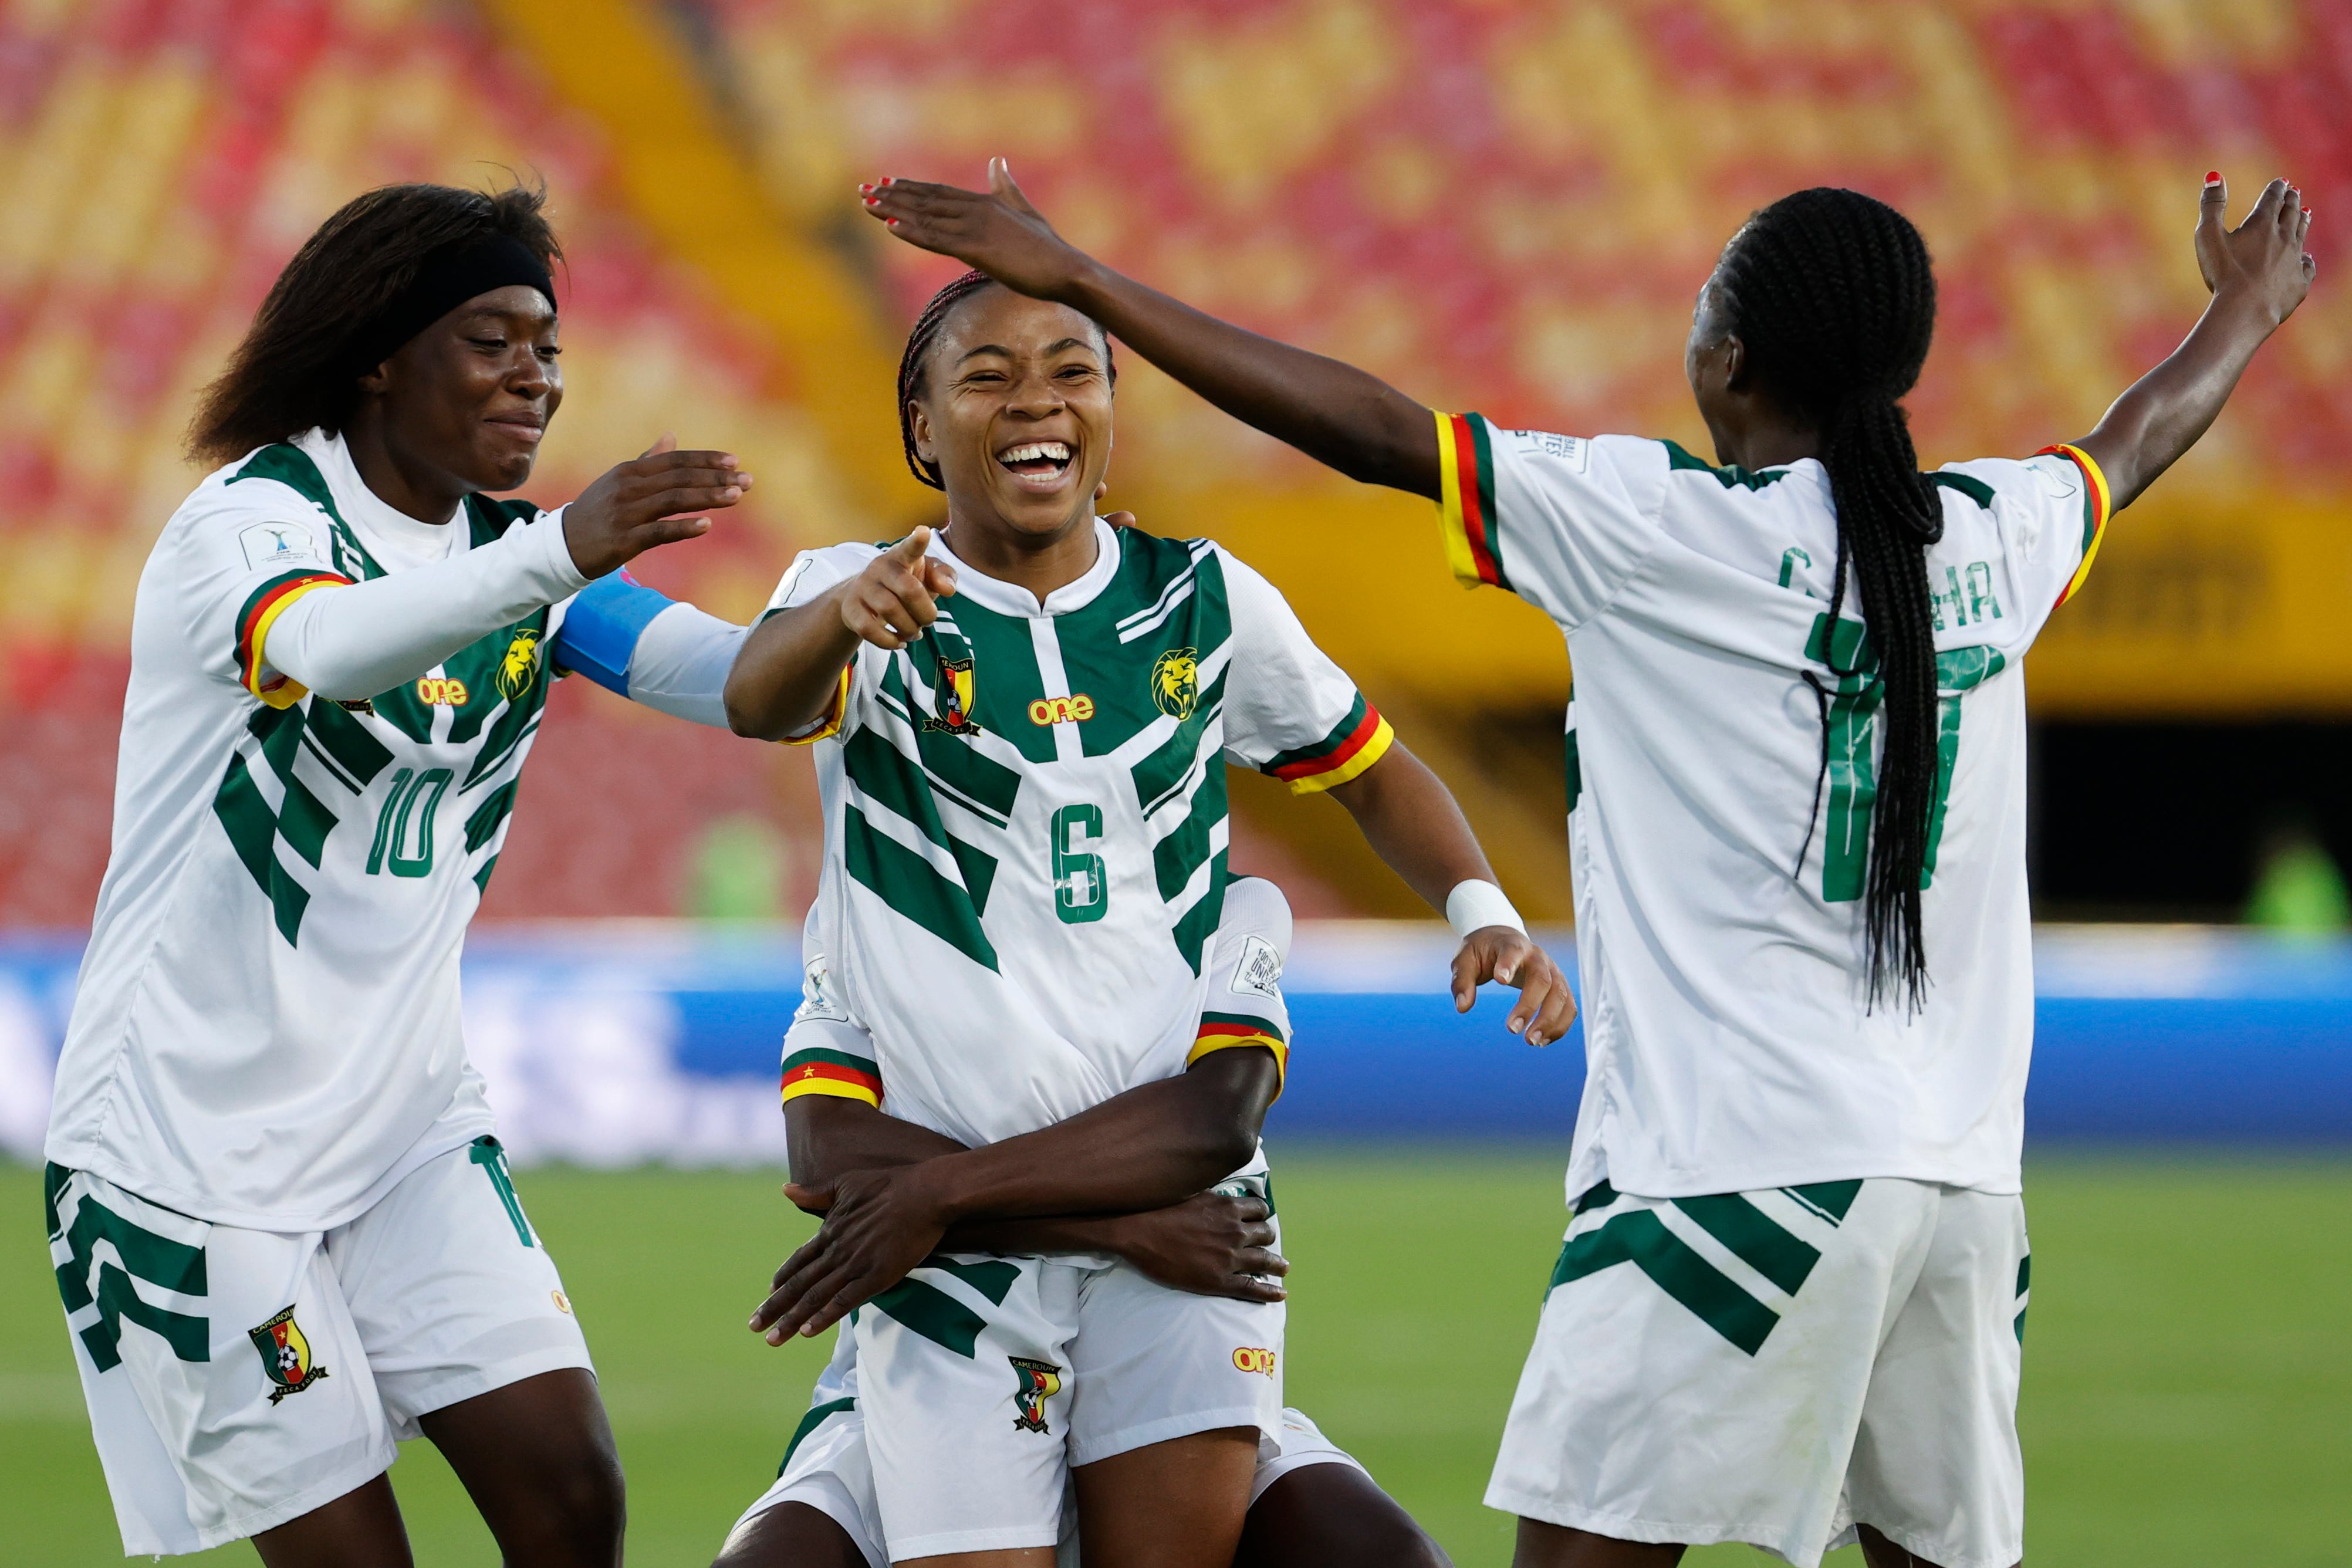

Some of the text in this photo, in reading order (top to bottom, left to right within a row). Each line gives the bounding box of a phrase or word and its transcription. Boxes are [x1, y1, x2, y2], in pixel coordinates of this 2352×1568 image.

[416, 677, 468, 706] one
[1028, 692, 1096, 726] one
[366, 768, 454, 878] 10
[1051, 803, 1108, 924] 6
[1013, 1360, 1055, 1371] CAMEROUN
[279, 1385, 300, 1394] FECA
